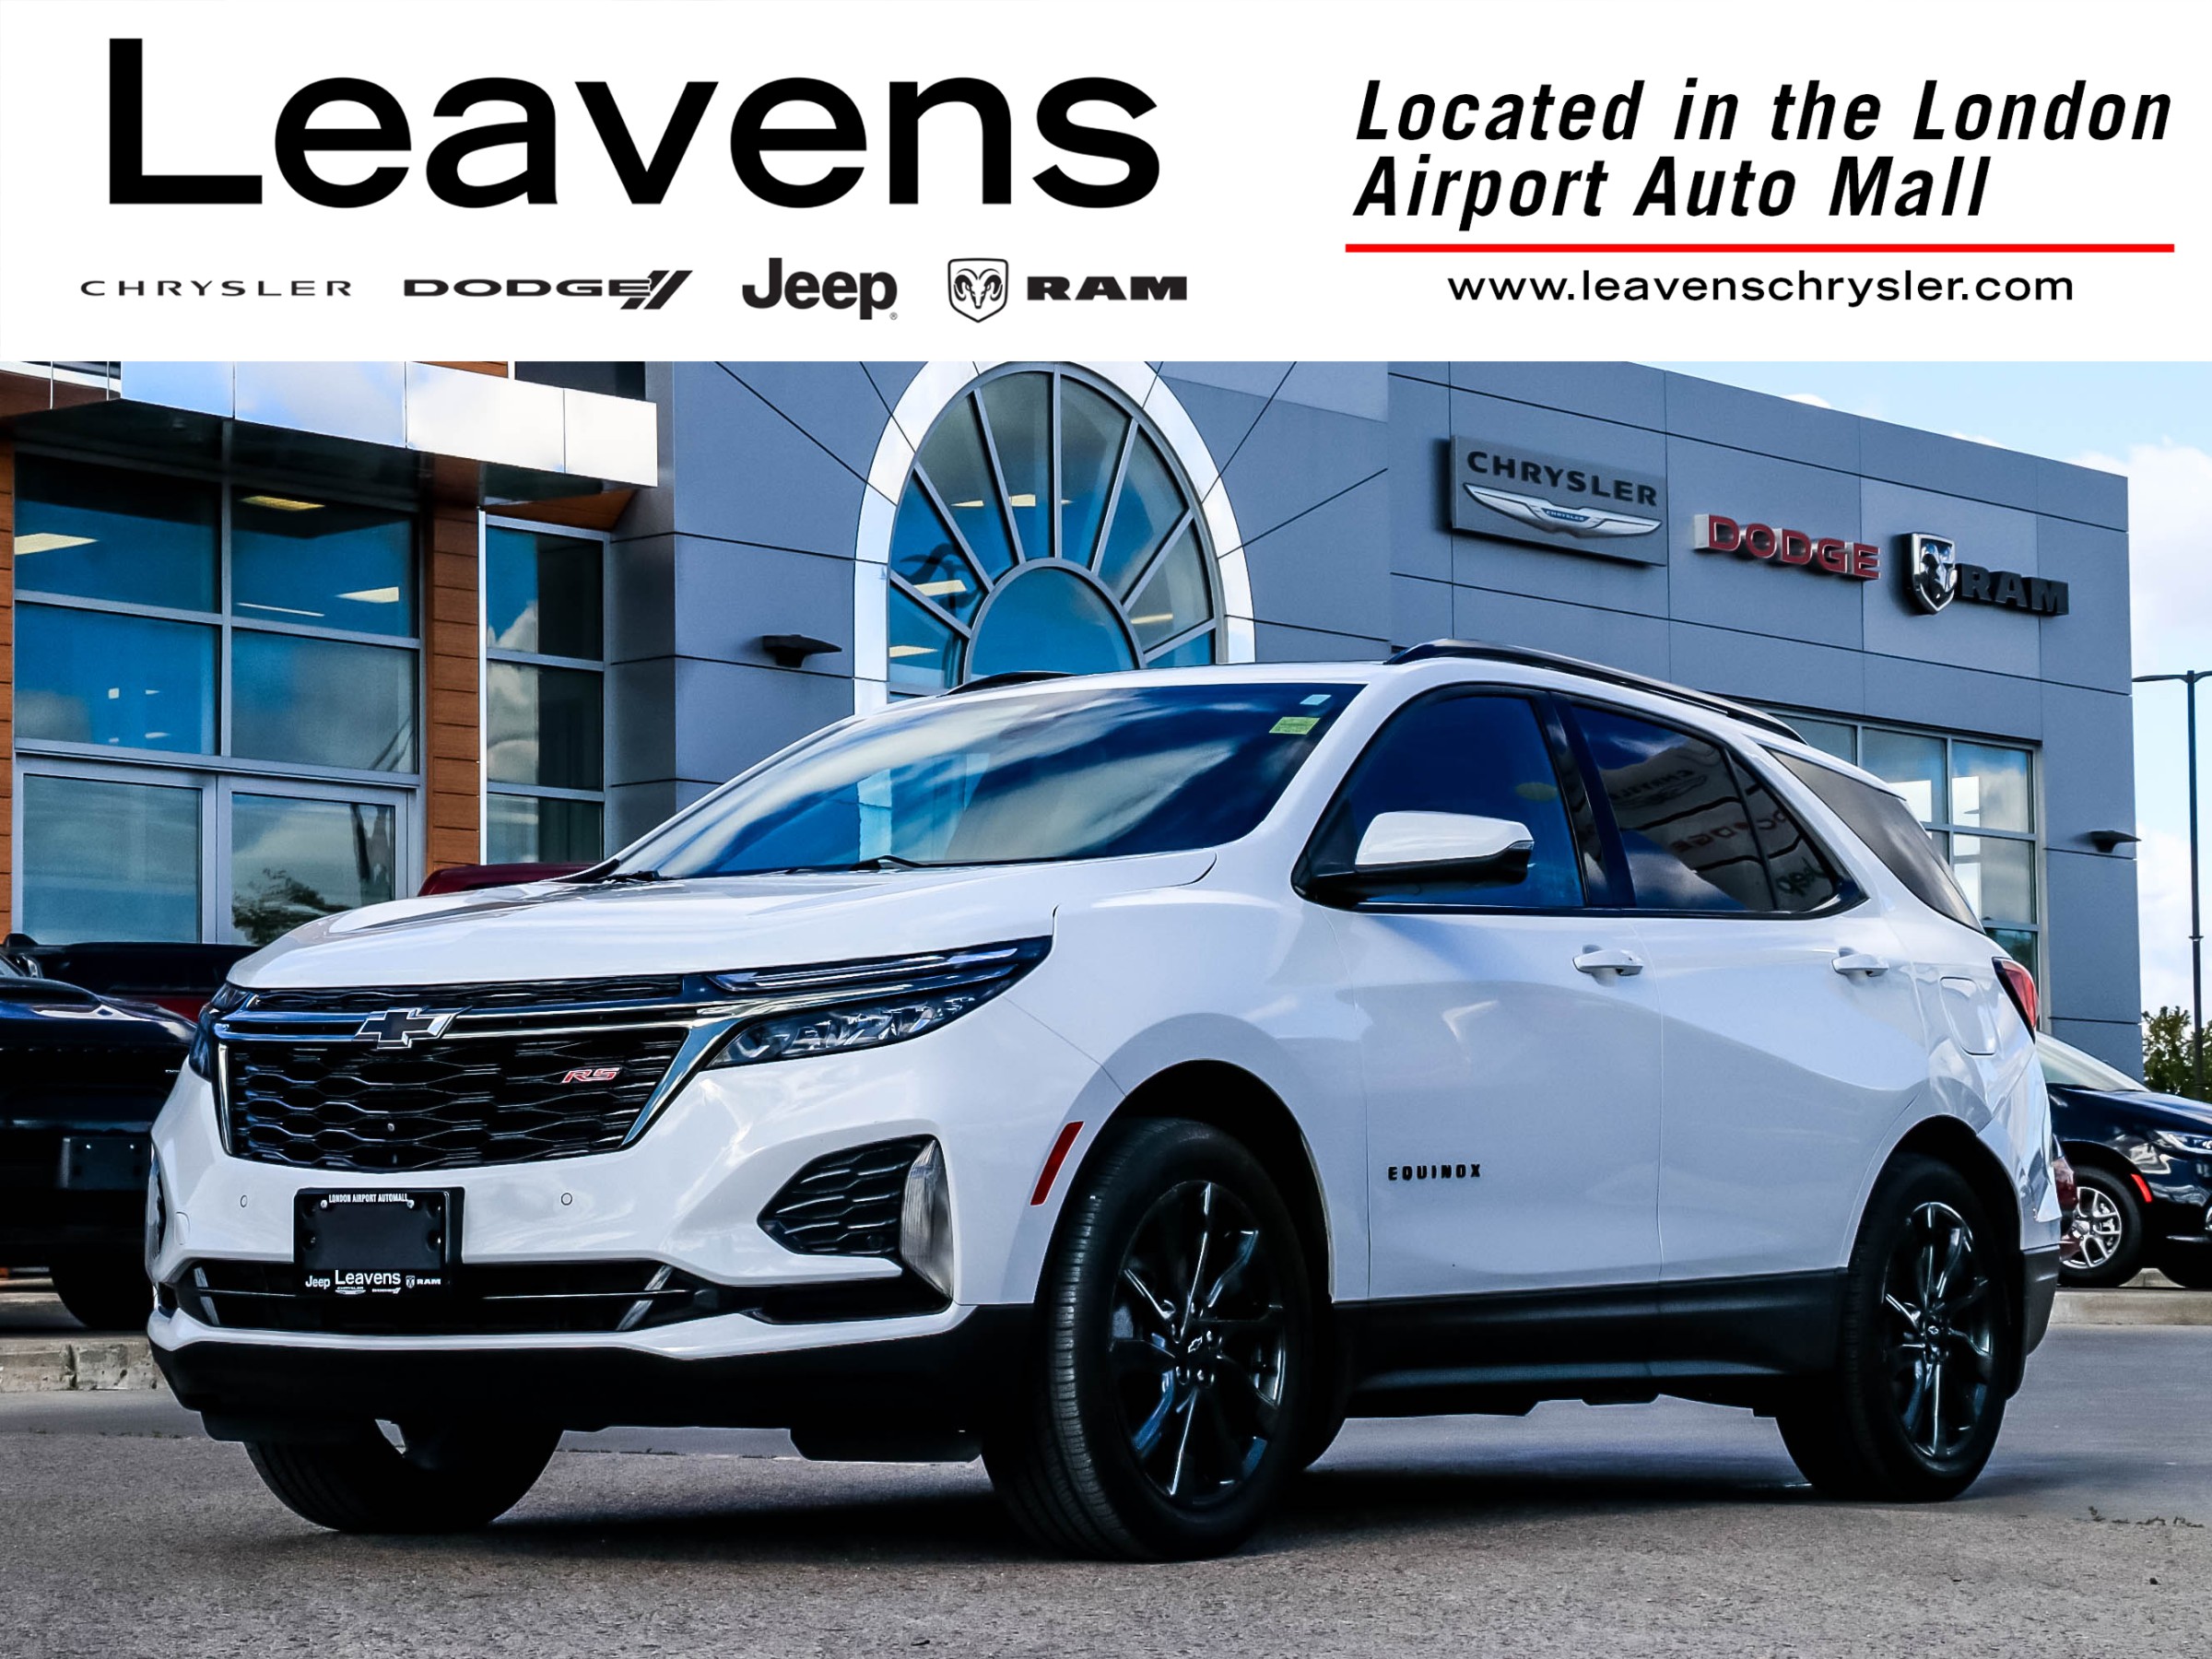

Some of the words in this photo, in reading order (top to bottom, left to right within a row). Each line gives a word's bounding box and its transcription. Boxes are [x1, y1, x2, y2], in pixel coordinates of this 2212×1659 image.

[1467, 452, 1656, 506] CHRYSLER
[1701, 514, 1879, 580] DODGE
[1959, 563, 2068, 616] RAM
[561, 1067, 620, 1084] RS
[1388, 1164, 1480, 1181] EQUINOX
[329, 1194, 351, 1203] LONDON
[352, 1194, 377, 1202] AIRPORT
[378, 1193, 407, 1202] AUTOMALL
[305, 1276, 331, 1289] Jeep
[335, 1269, 401, 1285] Leavens
